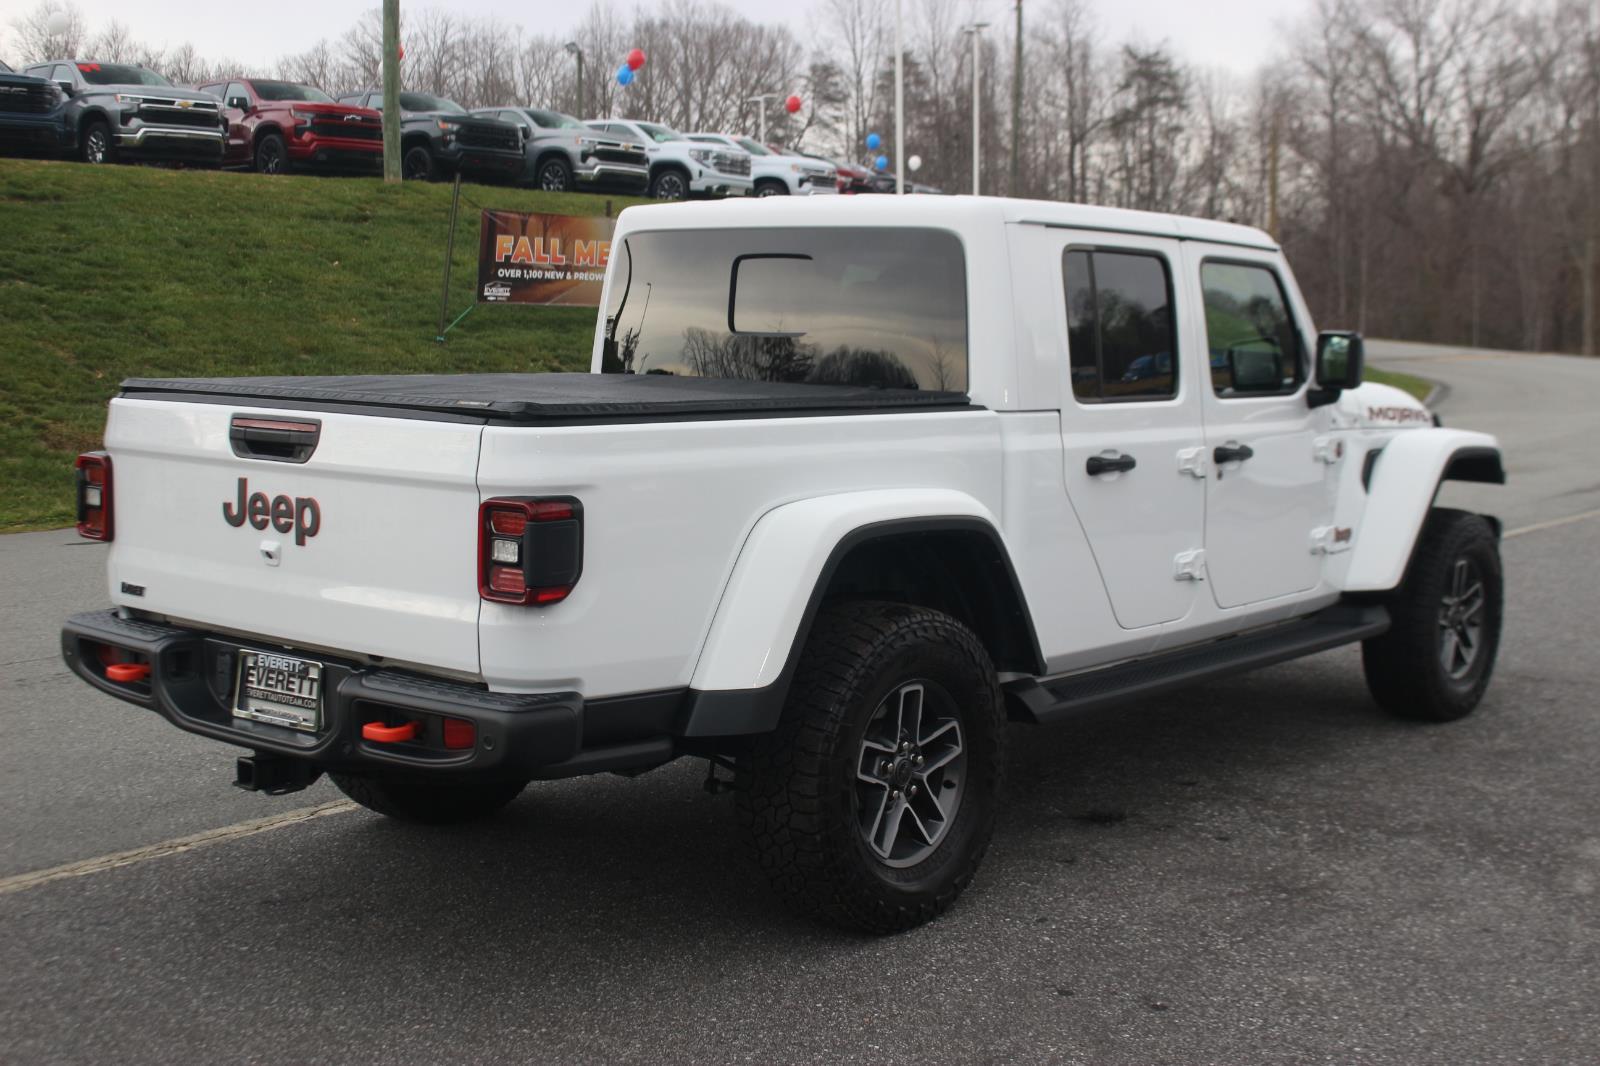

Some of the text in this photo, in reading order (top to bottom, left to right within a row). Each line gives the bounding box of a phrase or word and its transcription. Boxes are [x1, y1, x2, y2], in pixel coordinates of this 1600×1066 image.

[496, 234, 565, 265] FALL
[497, 268, 522, 278] OVER
[523, 269, 543, 280] 1,100
[544, 270, 565, 280] NEW
[566, 271, 571, 280] &
[223, 477, 321, 546] Jeep
[258, 654, 301, 672] EVERETT
[246, 667, 318, 697] EVERETT
[245, 689, 317, 709] EVERETTAUTOTEAM.COM
